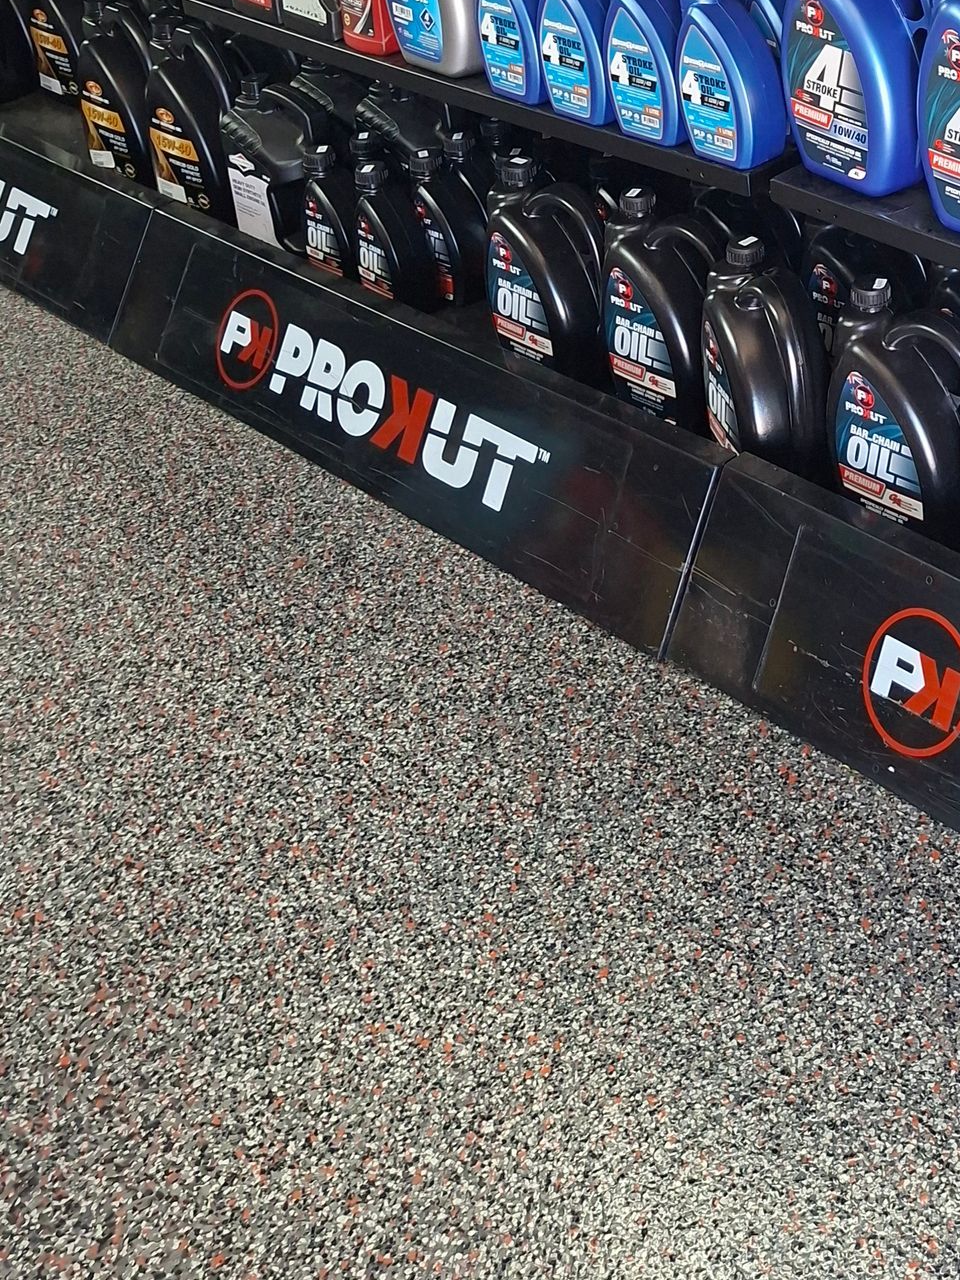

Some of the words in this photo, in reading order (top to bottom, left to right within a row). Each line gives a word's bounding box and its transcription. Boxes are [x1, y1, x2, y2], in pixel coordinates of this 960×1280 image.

[35, 31, 62, 50] 15W-40
[481, 13, 498, 45] 4
[490, 15, 516, 30] STROKE
[496, 25, 508, 36] OIL
[796, 20, 836, 42] PROKUT
[542, 32, 560, 66] 4
[552, 35, 582, 51] STROKE
[558, 45, 572, 57] OIL
[610, 51, 629, 87] 4
[622, 54, 654, 70] STROKE
[628, 65, 643, 77] OIL
[803, 43, 843, 113] 4
[682, 69, 702, 105] 4
[693, 72, 726, 90] STROKE
[701, 84, 715, 96] OIL
[805, 79, 839, 100] STROKE
[86, 106, 118, 127] 15W-40
[794, 103, 829, 125] PREMIUM
[156, 133, 192, 157] 15W-40
[832, 123, 867, 146] 10W/40
[307, 227, 330, 253] OIL
[359, 247, 382, 275] OIL
[497, 288, 531, 326] OIL
[614, 325, 652, 360] OIL
[269, 323, 538, 512] PROKUT
[845, 401, 888, 425] PROKUT
[846, 435, 895, 483] OIL
[844, 471, 880, 493] PREMIUM
